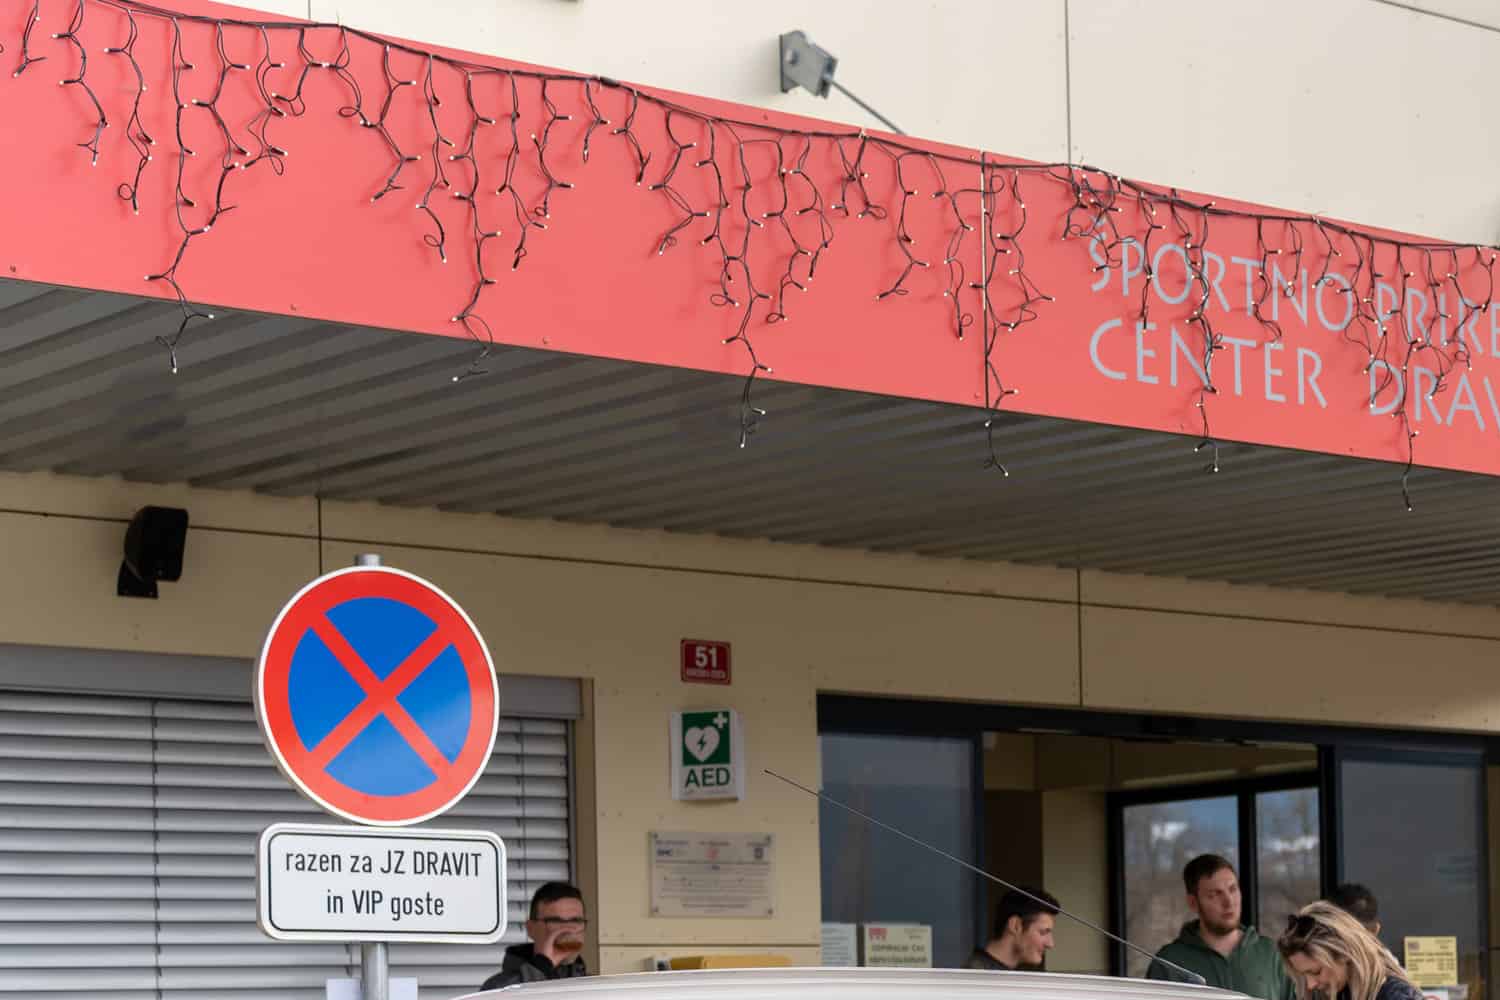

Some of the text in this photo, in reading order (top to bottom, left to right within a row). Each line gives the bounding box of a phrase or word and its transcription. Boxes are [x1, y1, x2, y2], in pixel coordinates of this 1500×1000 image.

[1088, 214, 1354, 332] ŠPORTNO
[1089, 318, 1328, 409] CENTER
[695, 646, 718, 669] 51
[684, 767, 731, 789] AED
[285, 850, 483, 877] razen za JZ DRAVIT
[326, 889, 445, 922] in VIP goste
